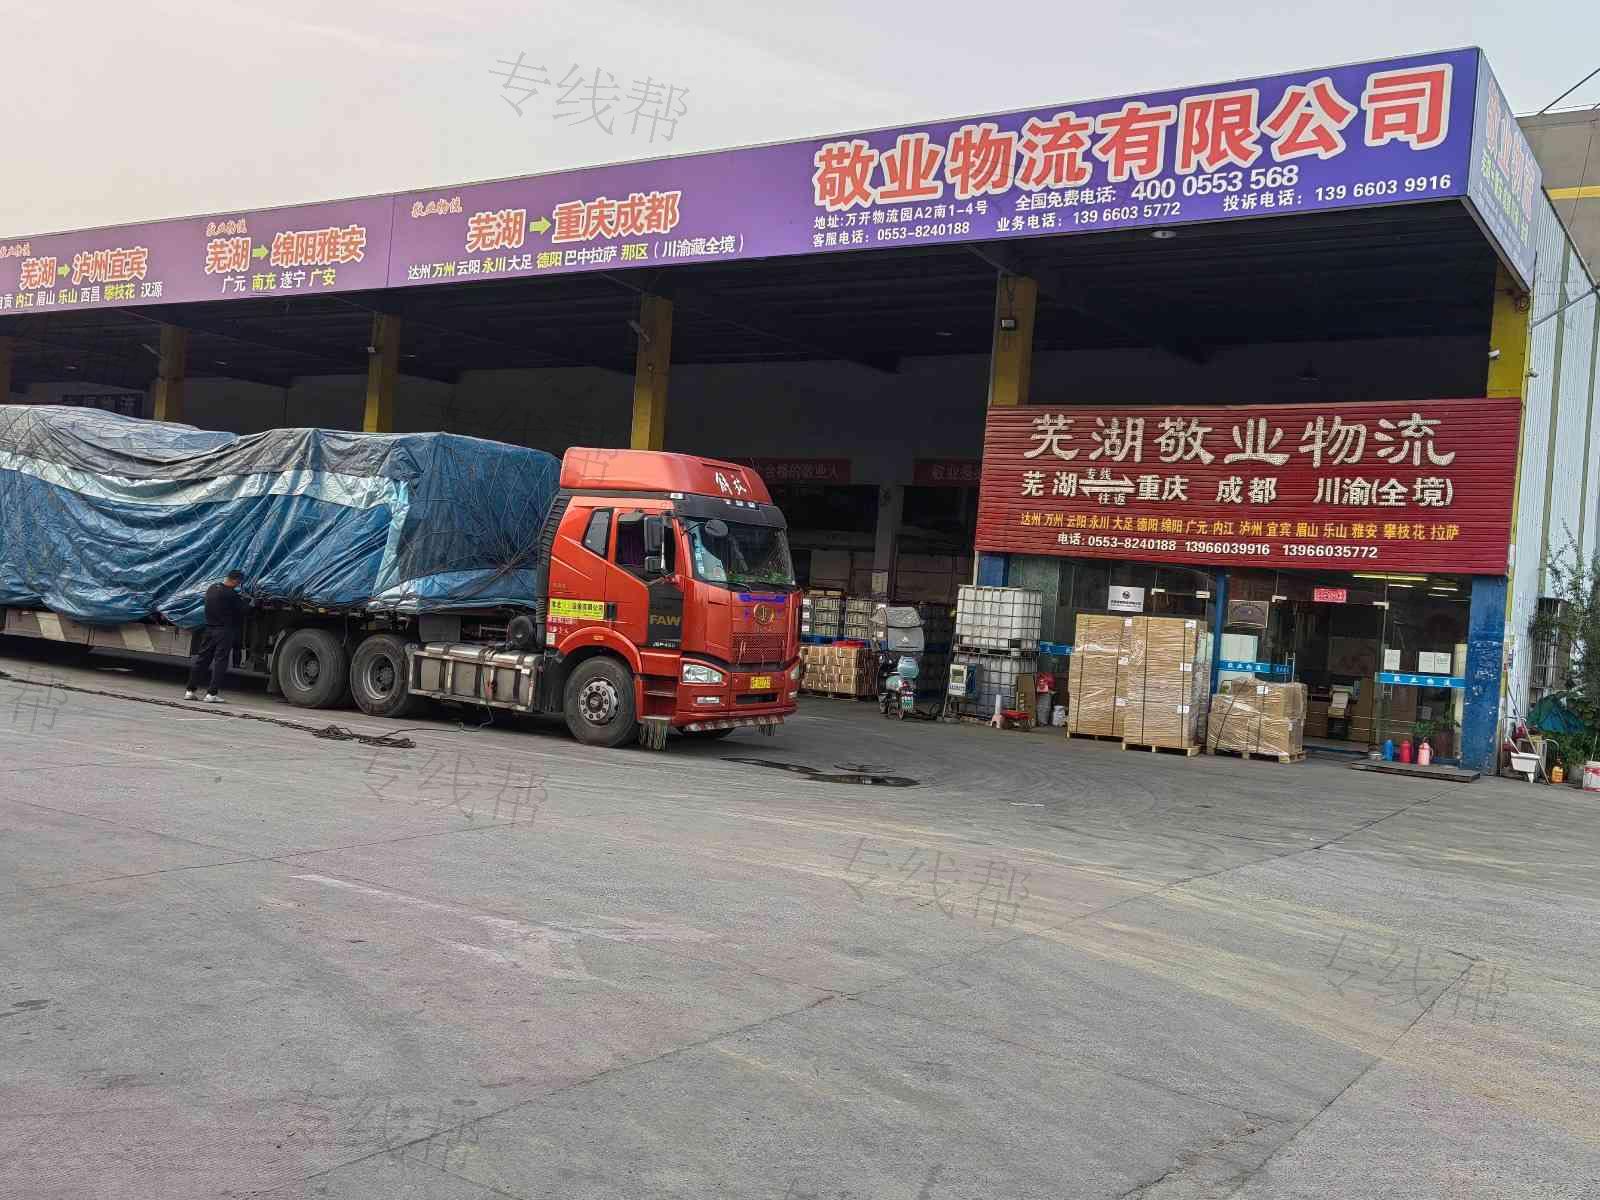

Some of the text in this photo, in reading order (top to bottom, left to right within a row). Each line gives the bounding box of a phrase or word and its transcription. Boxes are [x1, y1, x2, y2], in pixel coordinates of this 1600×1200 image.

[812, 63, 1453, 212] 敬业物流有限公司
[1015, 165, 1299, 212] 全国免费电话: 400 0553 568
[1223, 174, 1451, 212] 投诉电话: 139 6603 9916
[466, 190, 681, 253] 芜湖 重庆成都
[996, 202, 1181, 233] 业务电话: 139 6603 5772
[205, 224, 367, 274] 芜湖 绵阳雅安
[813, 222, 970, 248] 客服电话: 0553-8240188
[20, 256, 56, 290] 芜湖
[72, 246, 148, 285] 泸州宜宾
[222, 268, 336, 293] 广元 南充 遂宁 广安
[16, 292, 34, 308] 内江
[37, 290, 55, 306] 眉山
[58, 288, 77, 304] 乐山
[81, 286, 100, 302] 西昌
[140, 281, 163, 298] 汉源
[1023, 412, 1456, 468] 芜湖敬业物流
[1021, 470, 1078, 497] 芜湖
[1135, 475, 1189, 501] 重庆
[1215, 477, 1278, 504] 成都
[1021, 512, 1459, 541] 达州 万州 云阳 永川 大足 德阳 绵阳 广元 内江 泸州 宜宾 眉山 乐山 雅安 攀枝花 拉萨
[1057, 532, 1378, 559] 电话: 0553-8240188 13966039916 13966035772
[649, 614, 681, 626] FAW
